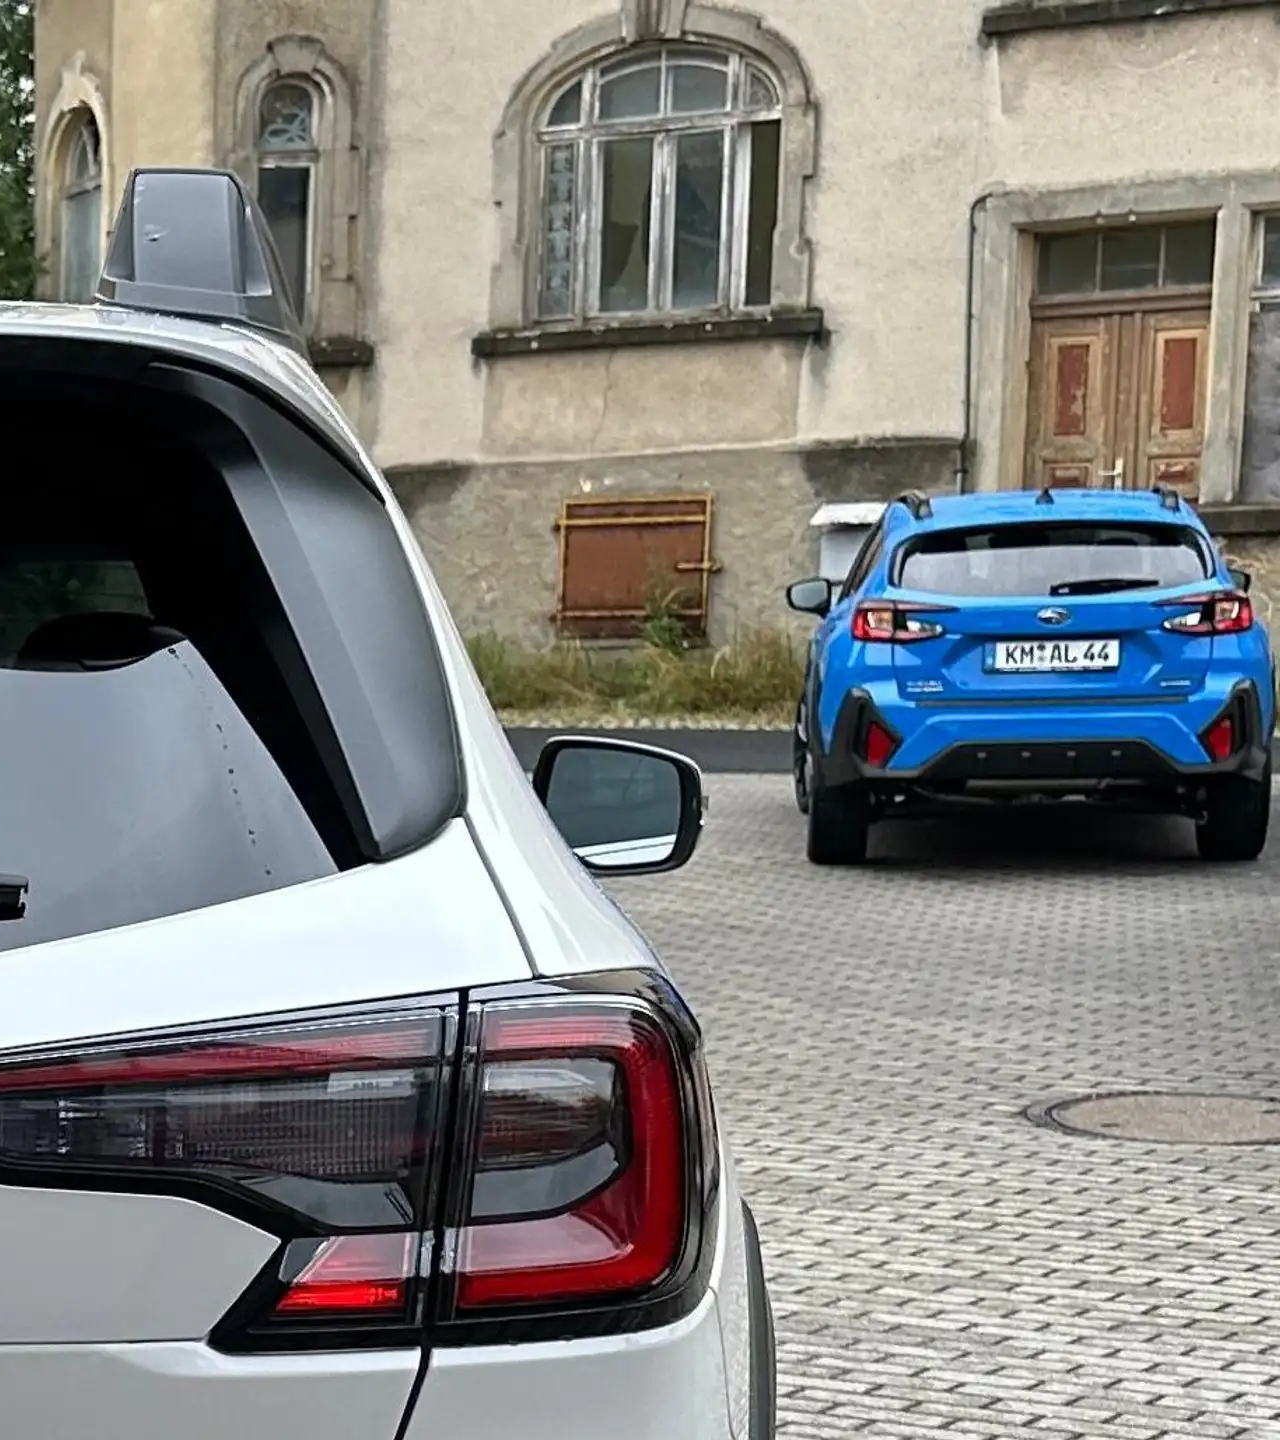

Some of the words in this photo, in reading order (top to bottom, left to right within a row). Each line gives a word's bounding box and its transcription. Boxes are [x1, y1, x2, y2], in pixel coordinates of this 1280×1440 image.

[1005, 644, 1035, 664] KM
[1050, 643, 1078, 664] AL
[1083, 642, 1109, 662] 44
